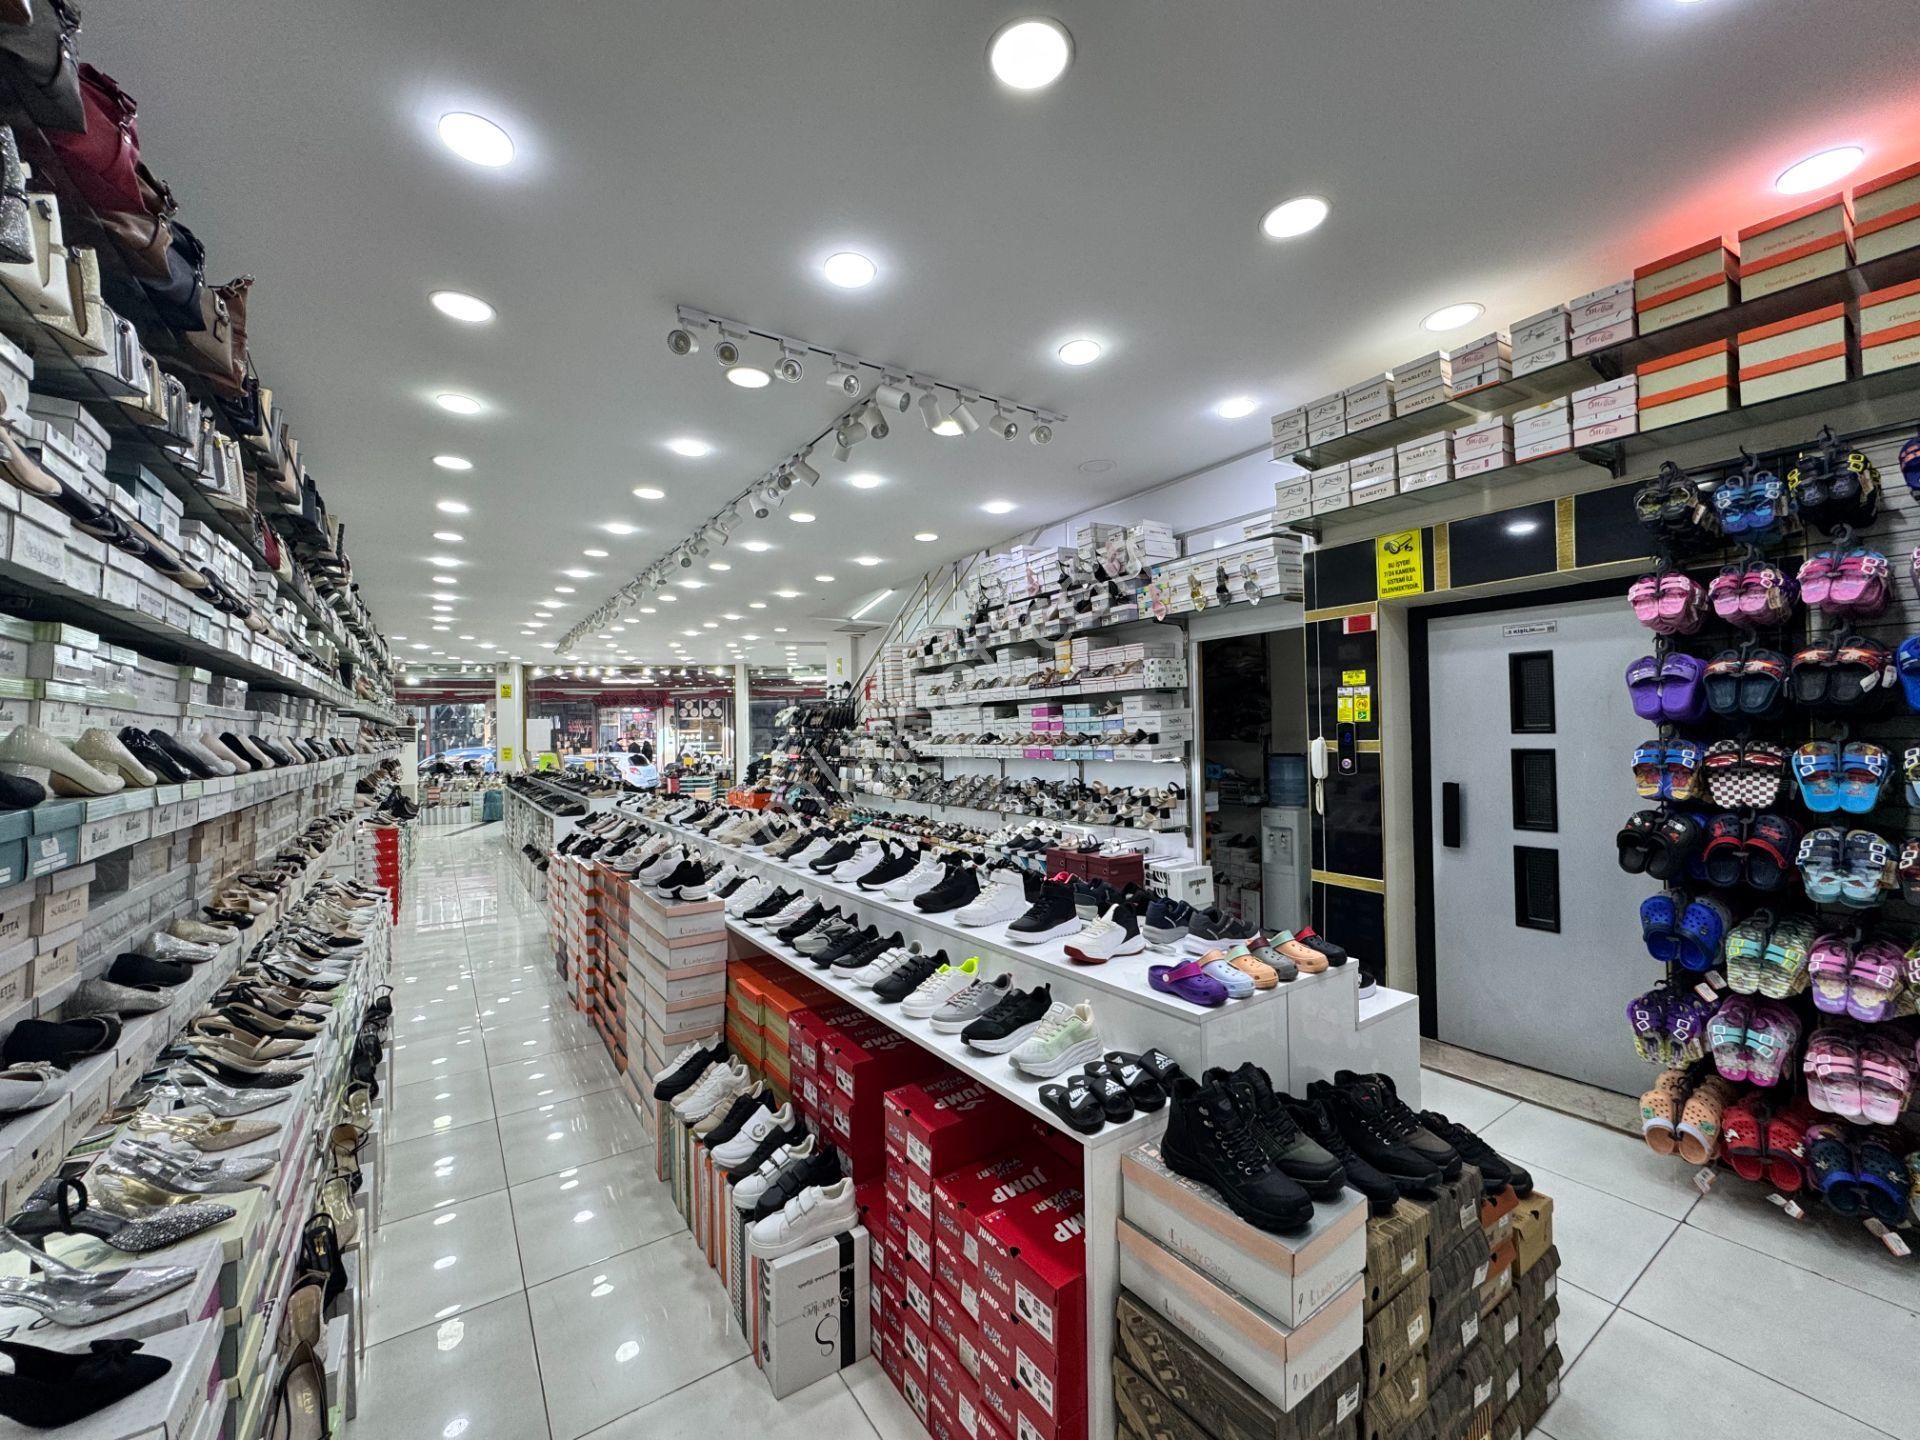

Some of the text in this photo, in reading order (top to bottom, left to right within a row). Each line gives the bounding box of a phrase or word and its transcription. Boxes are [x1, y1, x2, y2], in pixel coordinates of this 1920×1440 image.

[1395, 567, 1416, 575] KAMERA
[1069, 1087, 1087, 1101] NIKE
[992, 1166, 1047, 1203] JUMP
[978, 1226, 997, 1247] JUMP
[980, 1287, 999, 1310] JUMP
[980, 1349, 999, 1374] JUMP
[978, 1412, 996, 1438] JUMP
